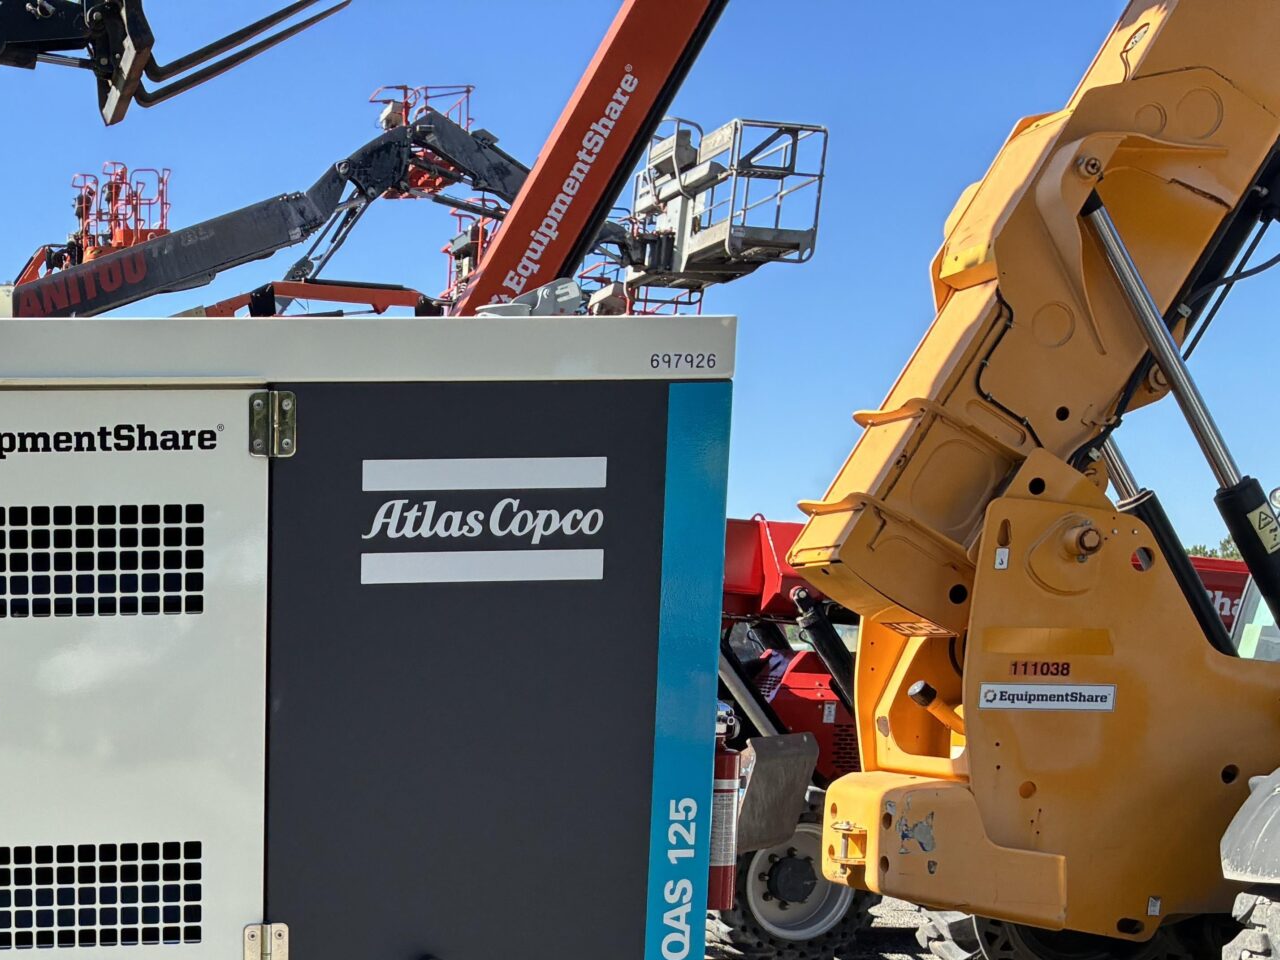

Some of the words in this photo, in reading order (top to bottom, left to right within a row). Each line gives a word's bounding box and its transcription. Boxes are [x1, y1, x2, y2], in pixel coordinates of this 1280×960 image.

[502, 72, 639, 294] EquipmentShare
[650, 353, 717, 369] 697926
[361, 499, 485, 540] Atlas
[489, 497, 605, 545] Copco
[1011, 661, 1071, 676] 111038
[999, 691, 1108, 704] EquipmentShare
[667, 797, 698, 865] 125
